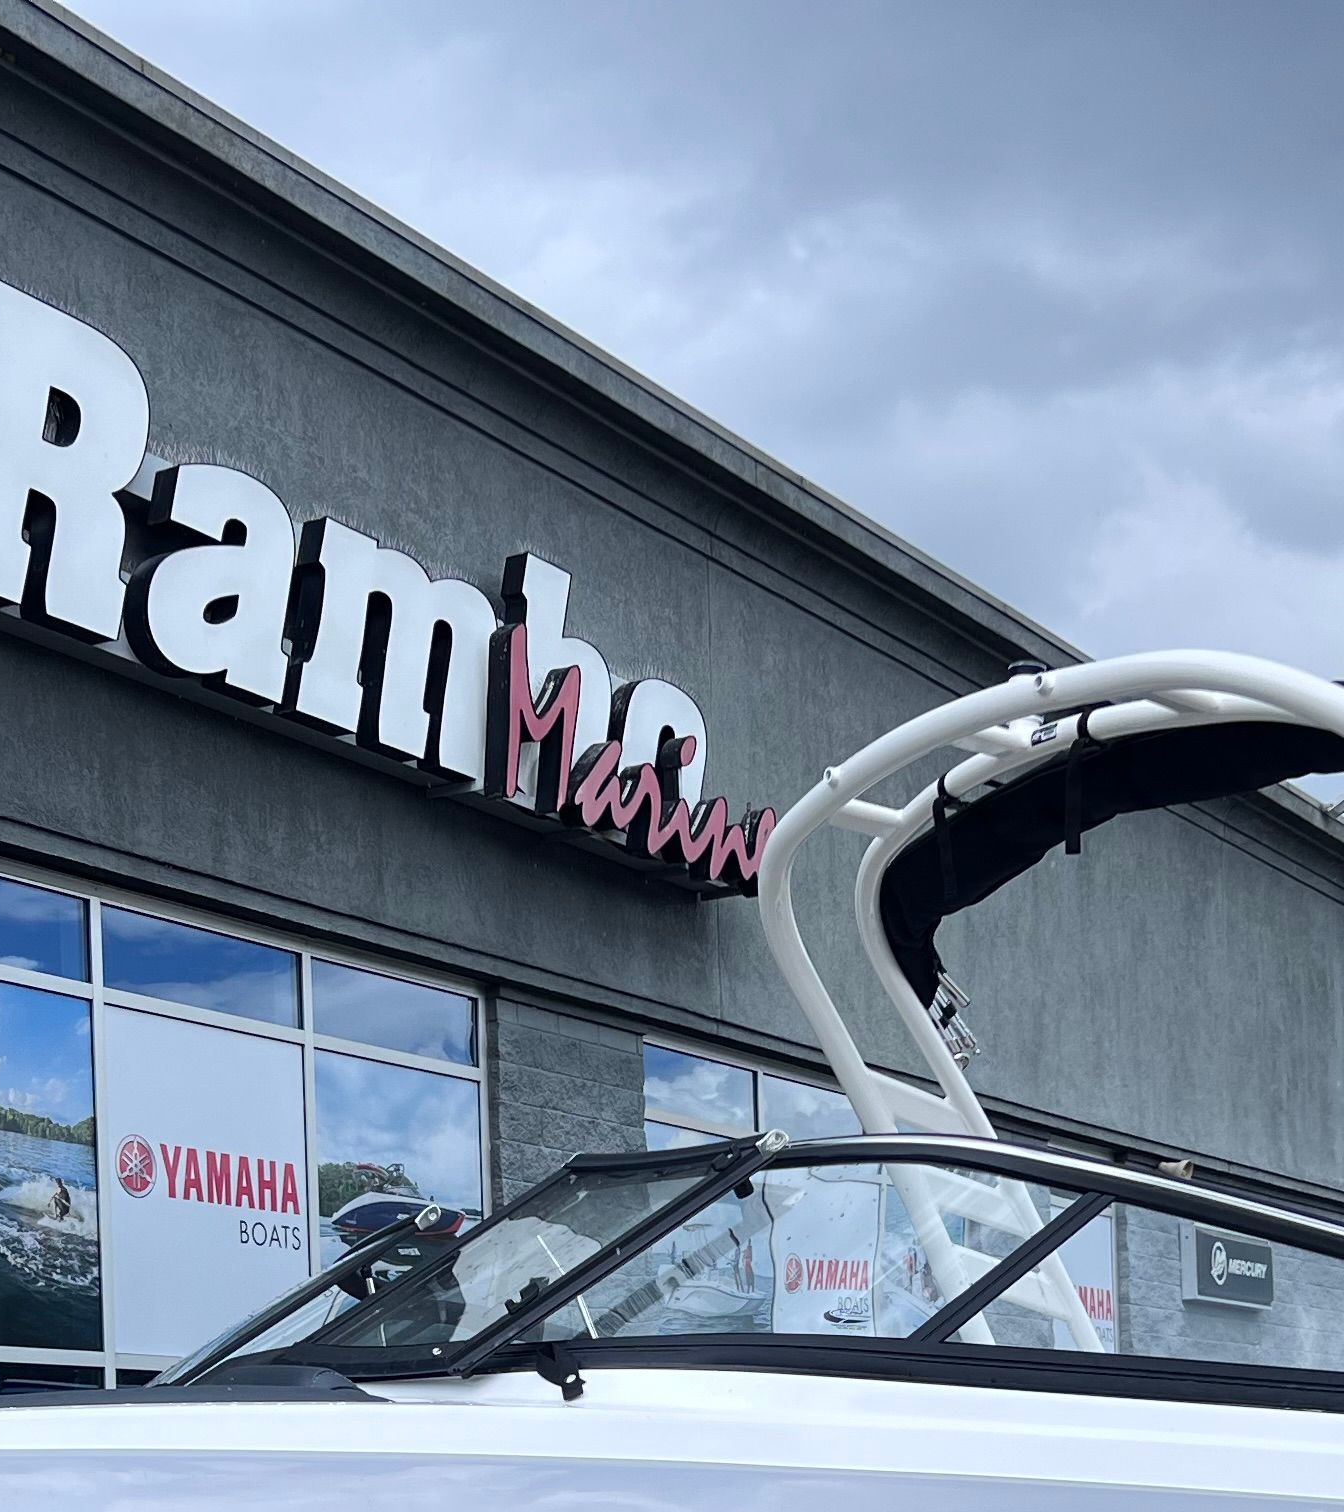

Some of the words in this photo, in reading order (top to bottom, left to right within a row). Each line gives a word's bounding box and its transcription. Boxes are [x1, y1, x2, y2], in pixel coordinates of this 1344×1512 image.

[159, 1143, 301, 1216] YAMAHA
[239, 1219, 302, 1251] BOATS
[805, 1257, 870, 1291] YAMAHA
[1227, 1257, 1269, 1280] MERCURY
[1076, 1285, 1113, 1321] MAHA
